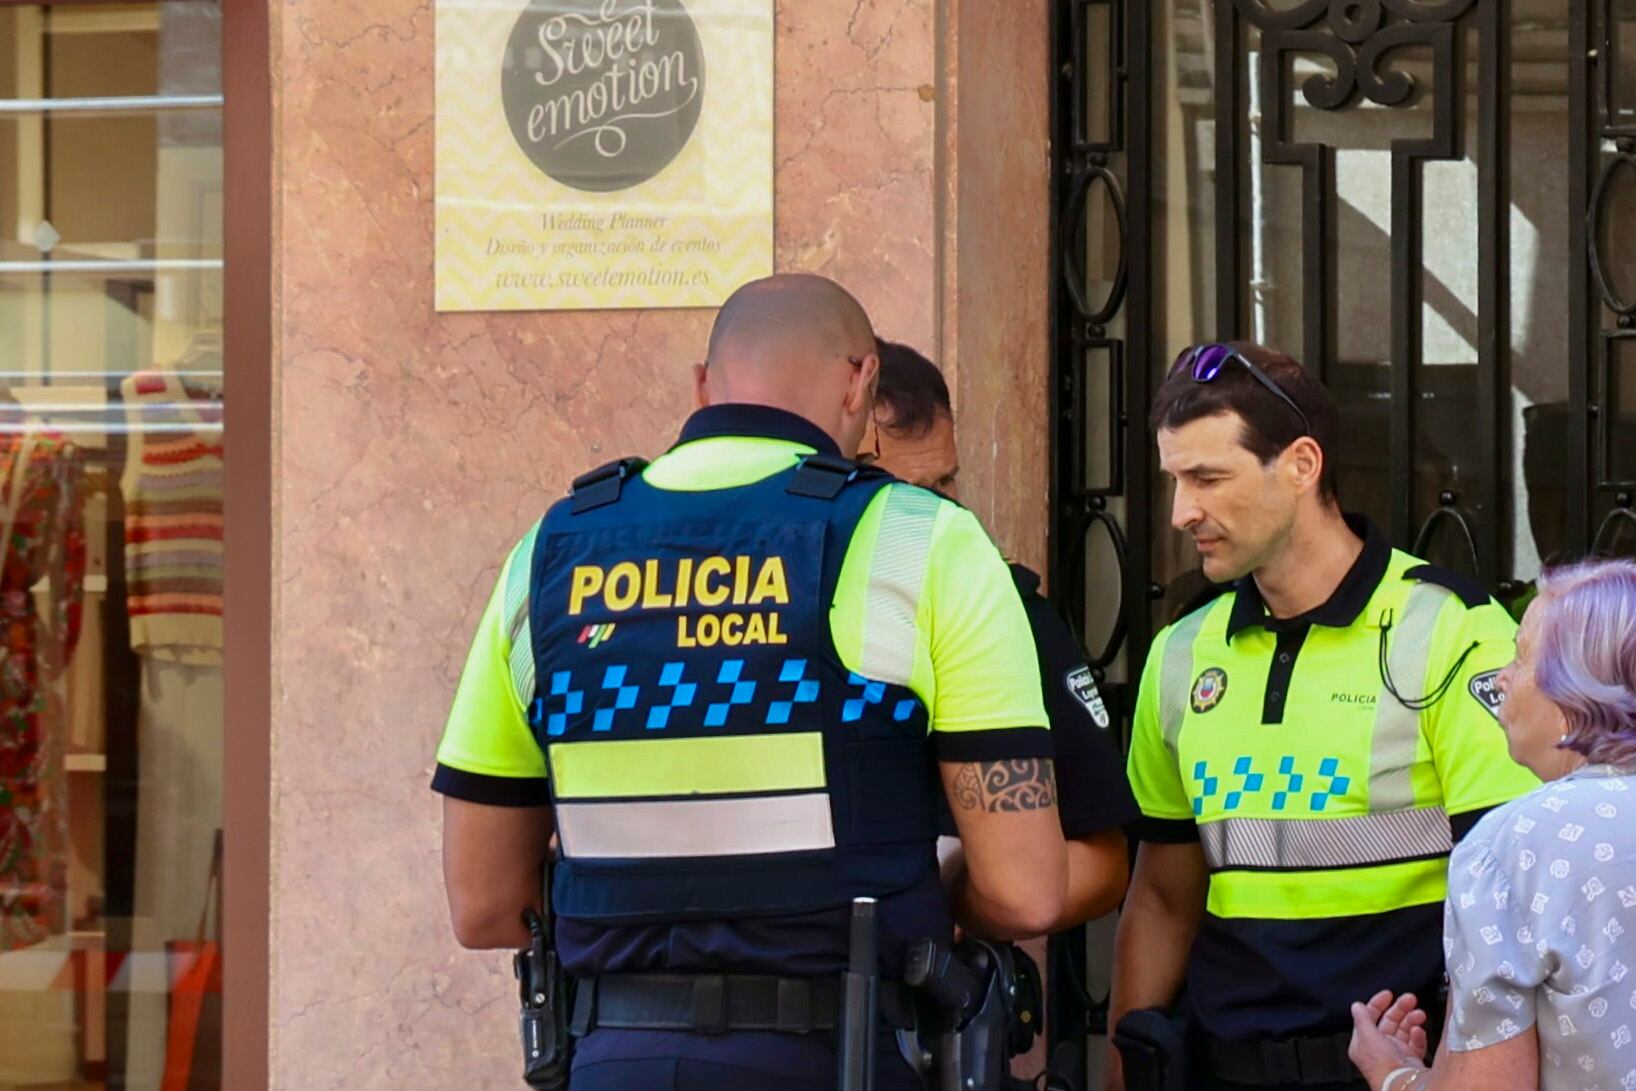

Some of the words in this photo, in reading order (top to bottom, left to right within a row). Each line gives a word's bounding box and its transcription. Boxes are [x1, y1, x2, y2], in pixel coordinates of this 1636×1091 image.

[535, 0, 660, 86] Sweet
[527, 51, 698, 143] emotion
[541, 212, 604, 232] Wedding
[610, 211, 667, 229] Planner
[552, 238, 645, 260] organización
[650, 235, 668, 252] de
[671, 238, 722, 251] eventos
[495, 262, 711, 288] www.sweetemotion.es
[568, 555, 789, 616] POLICIA
[677, 612, 788, 648] LOCAL
[1331, 693, 1376, 704] POLICIA
